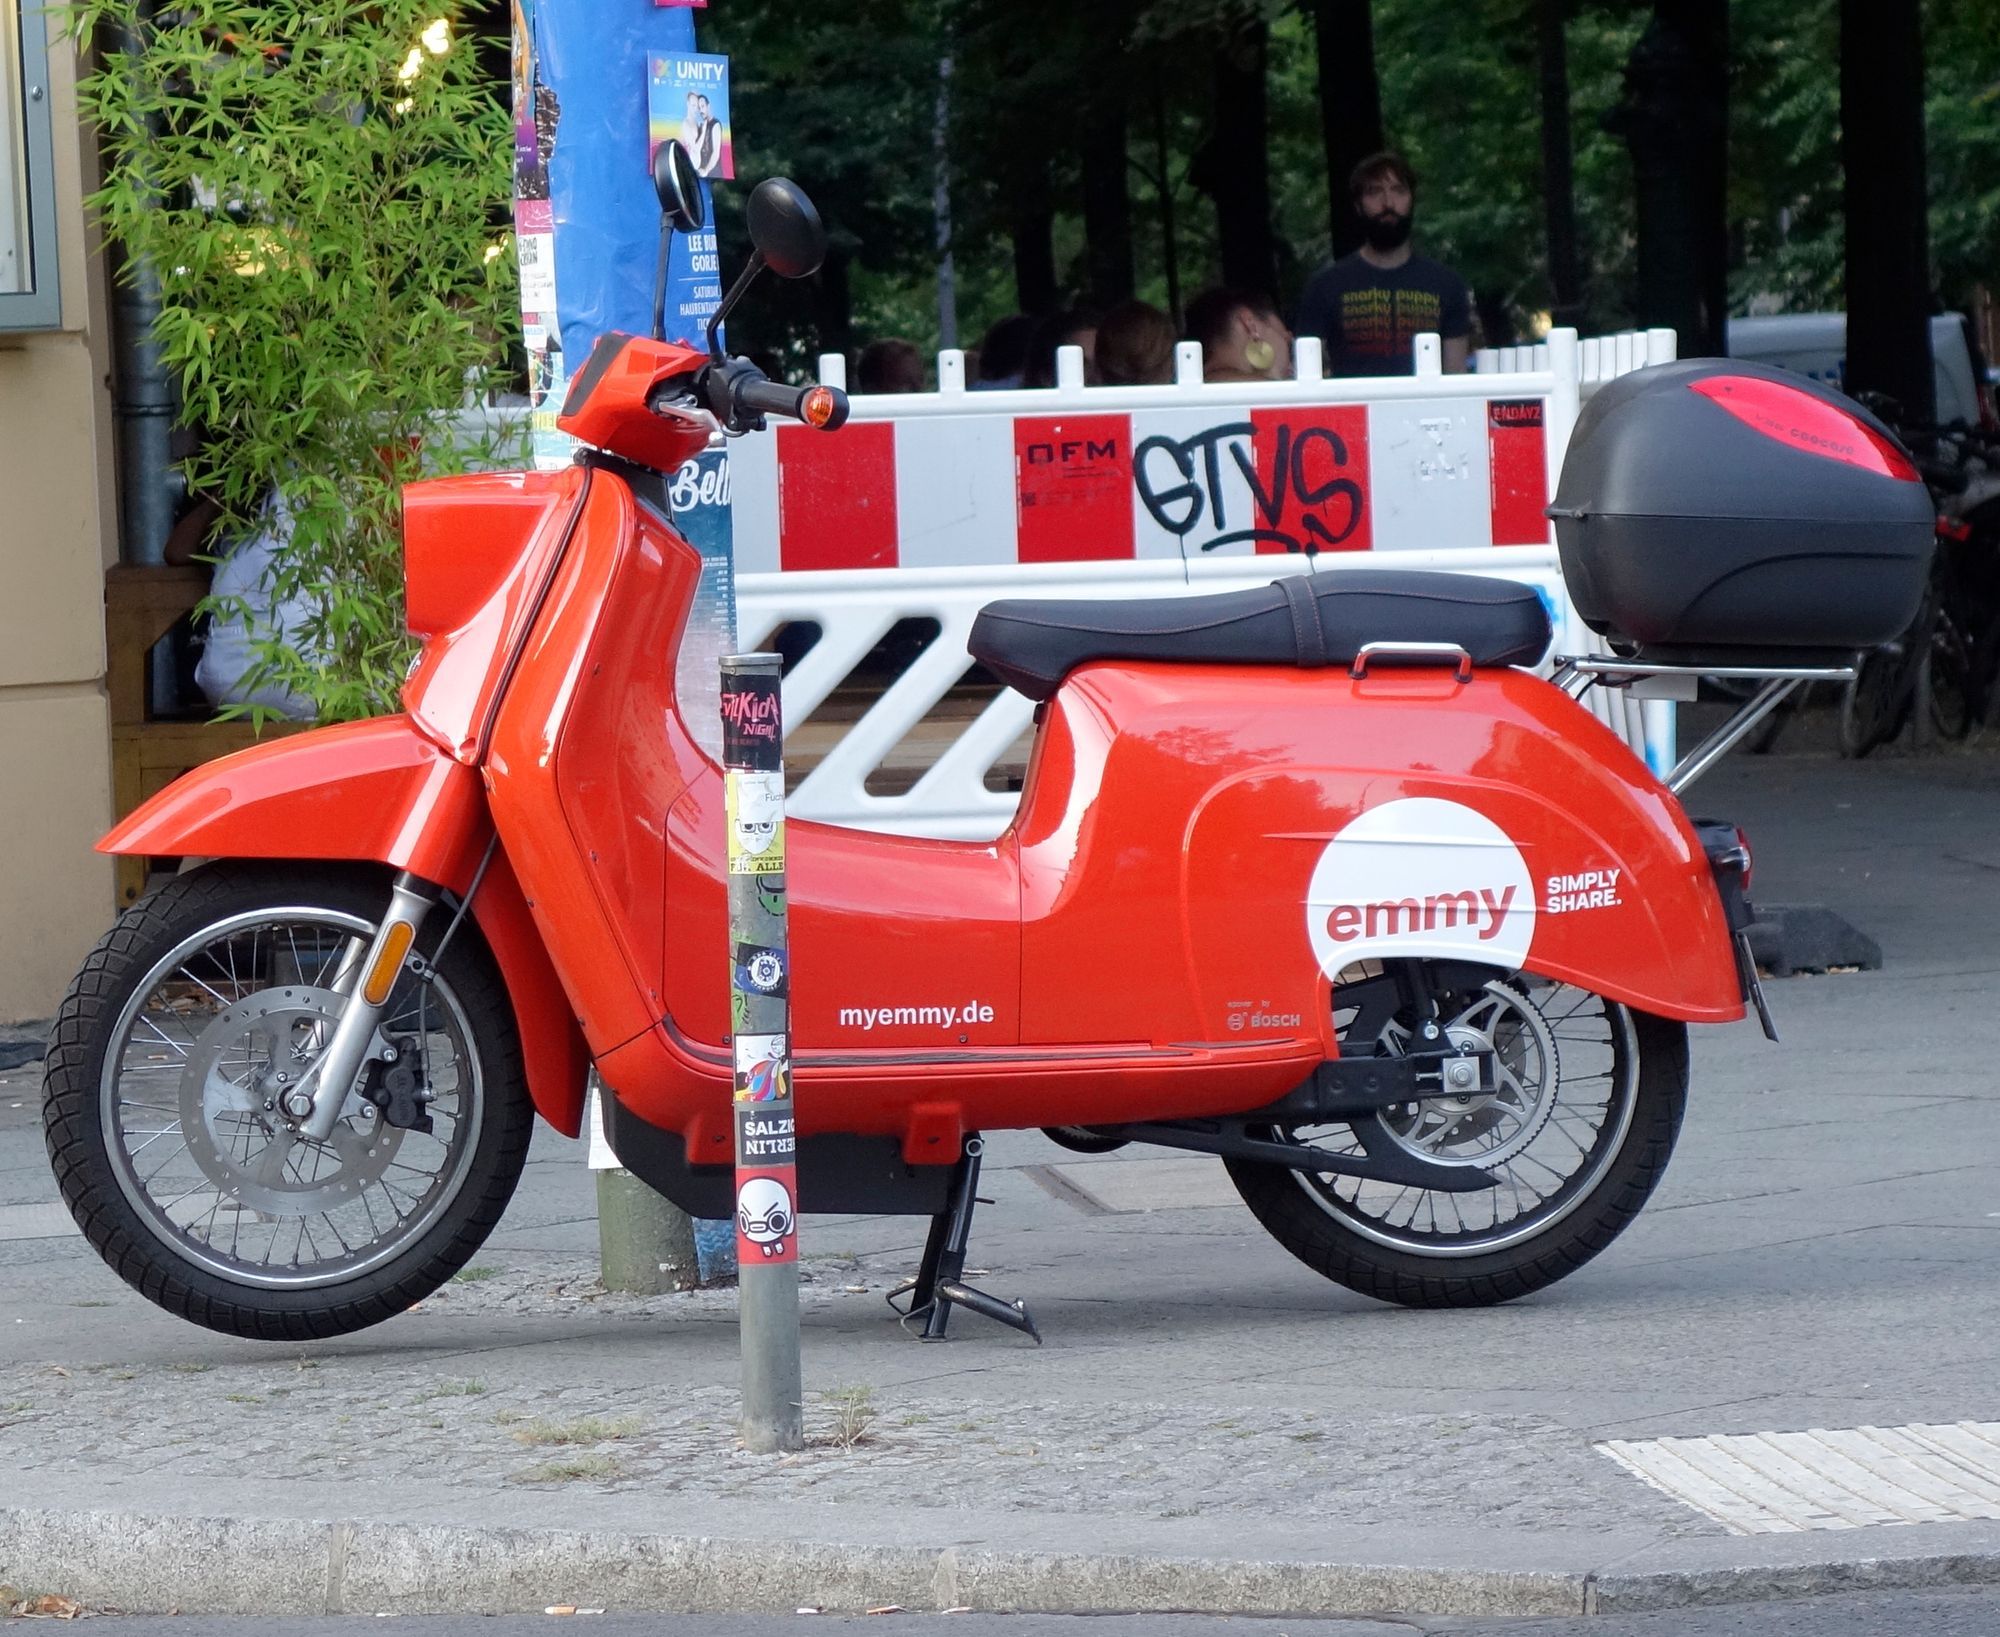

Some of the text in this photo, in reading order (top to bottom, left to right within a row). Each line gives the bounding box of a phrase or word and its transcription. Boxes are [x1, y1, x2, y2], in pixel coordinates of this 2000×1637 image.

[676, 61, 724, 80] UNITY
[688, 235, 702, 252] LEE
[756, 862, 784, 871] ALLE
[1547, 868, 1621, 895] SIMPLY
[1547, 890, 1623, 914] SHARE.
[1326, 885, 1517, 942] emmy
[840, 1000, 994, 1030] myemmy.de
[1251, 1014, 1301, 1028] BOSCH
[745, 1137, 796, 1155] ERLIN
